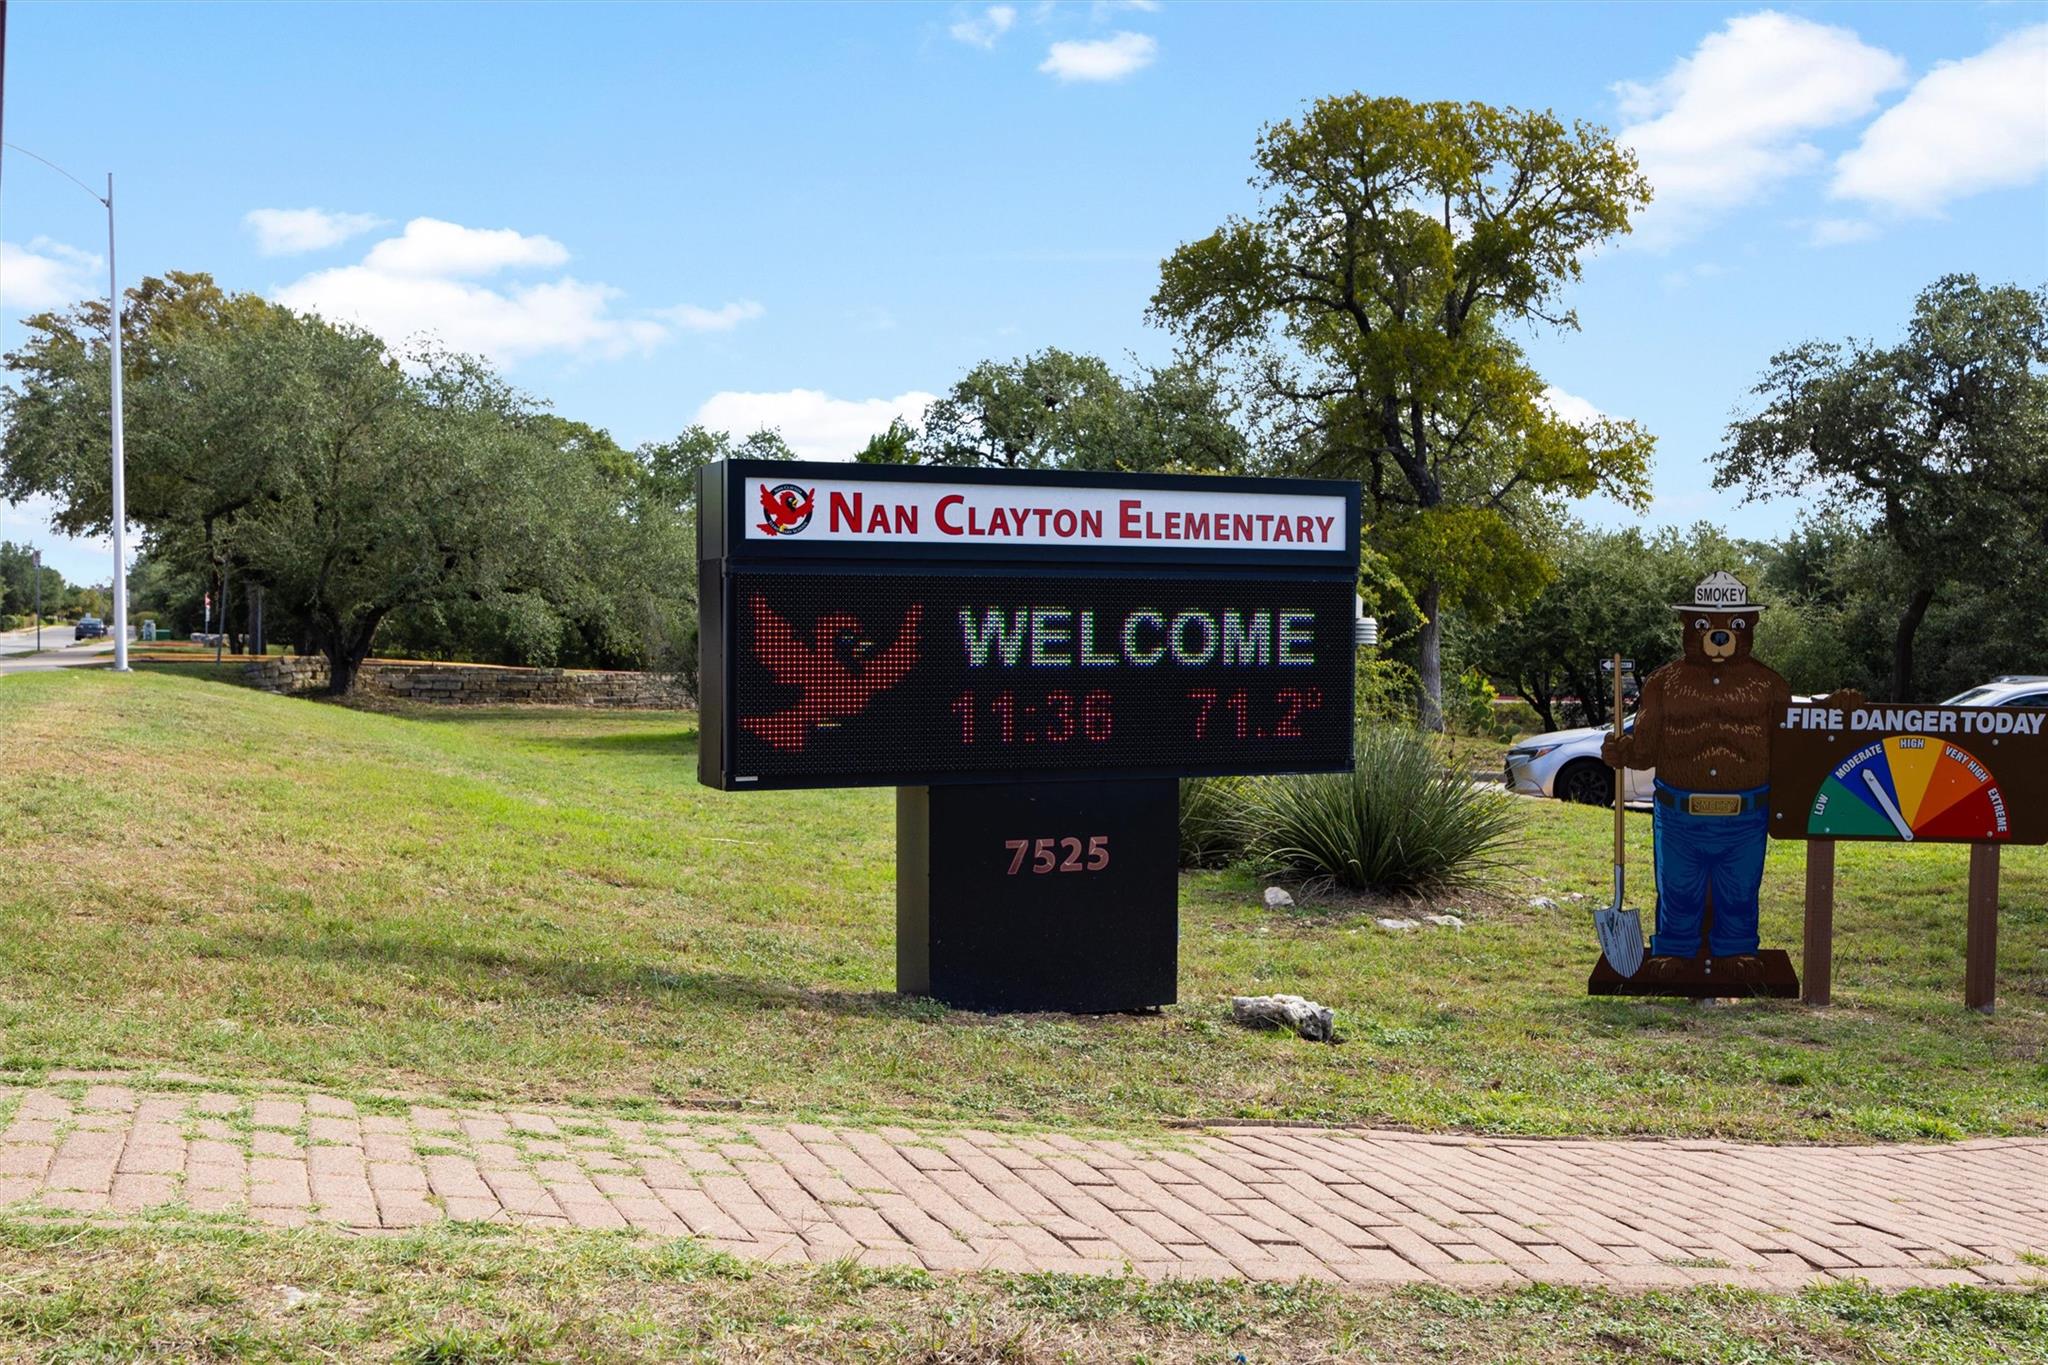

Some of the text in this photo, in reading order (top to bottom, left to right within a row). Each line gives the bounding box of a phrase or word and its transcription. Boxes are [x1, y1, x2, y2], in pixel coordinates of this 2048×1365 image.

[829, 491, 1335, 543] NAN CLAYTON ELEMENTARY
[1696, 587, 1745, 602] SMOKEY
[958, 605, 1316, 667] WELCOME
[951, 689, 1113, 743] 11:36
[1786, 707, 2047, 735] FIRE DANGER TODAY
[1835, 743, 1884, 780] MODERATE
[1900, 738, 1925, 749] HIGH
[1945, 745, 1989, 783] VERY HIGH
[1813, 793, 1829, 816] LOW
[1987, 787, 2008, 832] EXTREME
[1005, 836, 1110, 875] 7525
